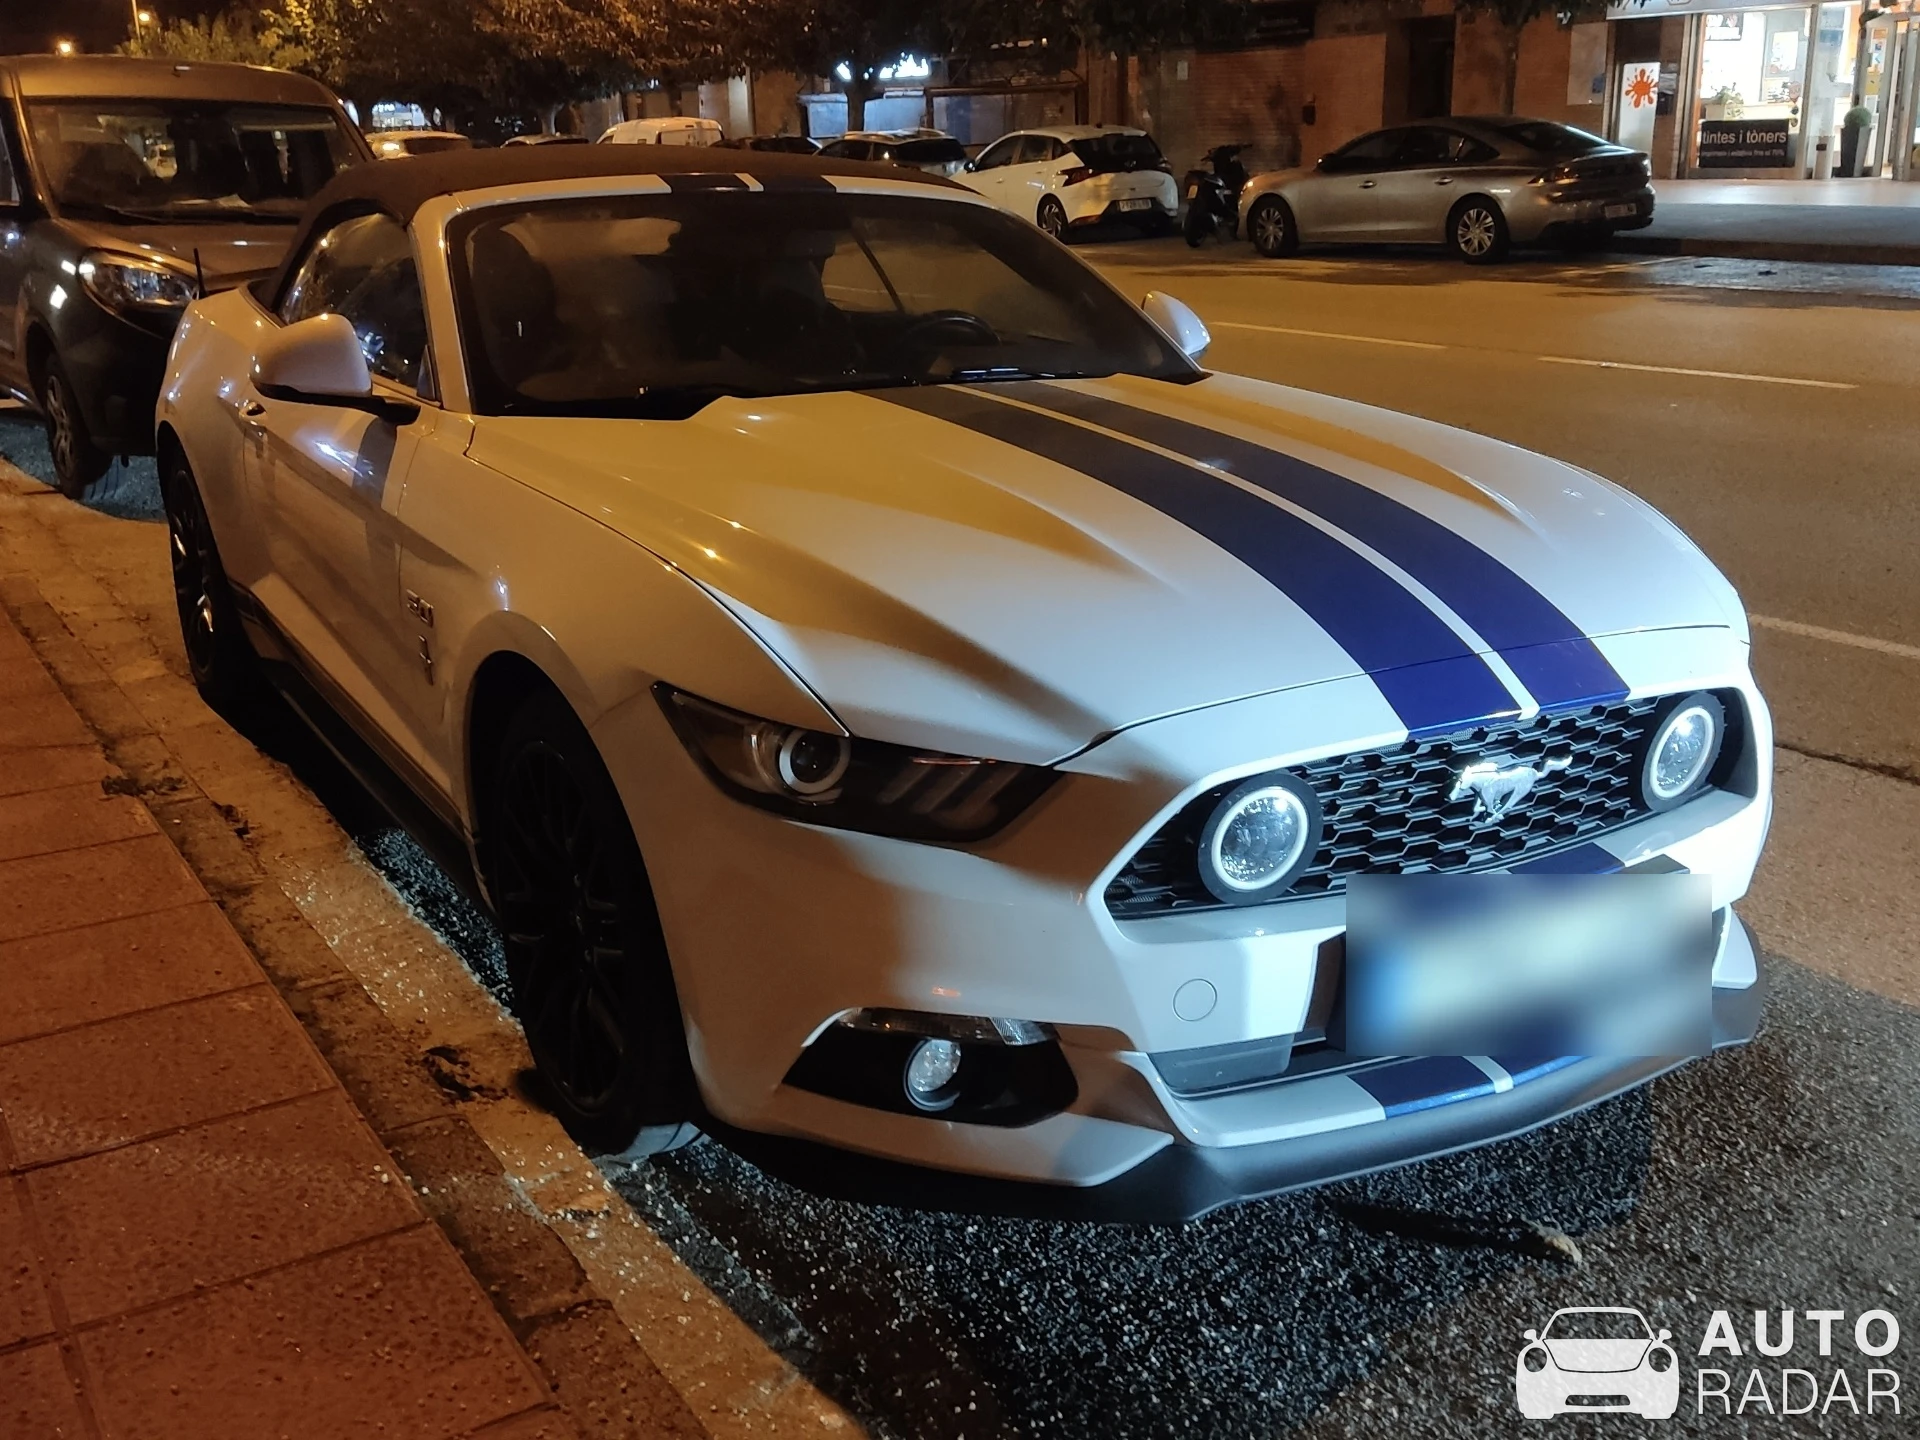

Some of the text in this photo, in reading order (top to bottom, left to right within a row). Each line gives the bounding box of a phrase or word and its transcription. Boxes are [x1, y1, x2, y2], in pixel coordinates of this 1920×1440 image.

[1702, 129, 1787, 144] tintes i tòners
